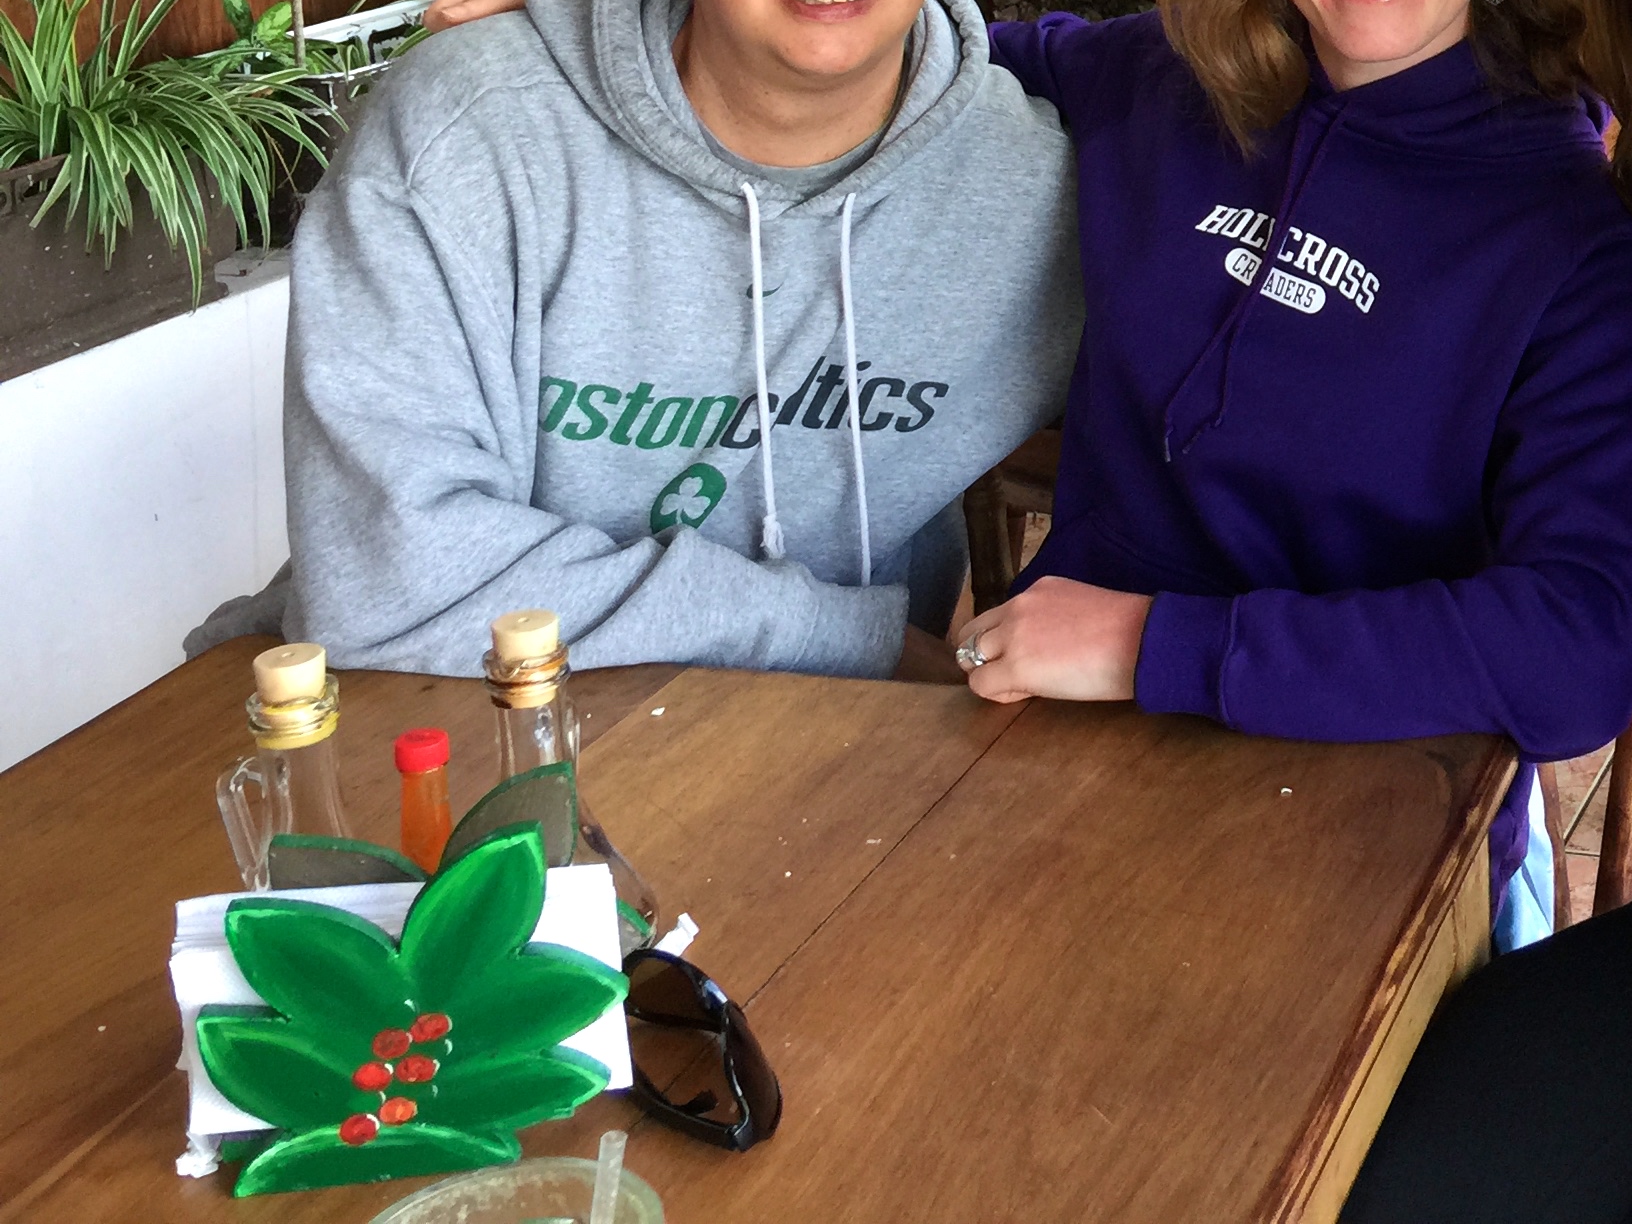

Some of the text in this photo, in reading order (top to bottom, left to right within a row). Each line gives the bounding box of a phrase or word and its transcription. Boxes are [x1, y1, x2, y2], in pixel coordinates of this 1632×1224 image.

[1277, 226, 1380, 313] CROSS
[540, 355, 949, 449] oston cltics
